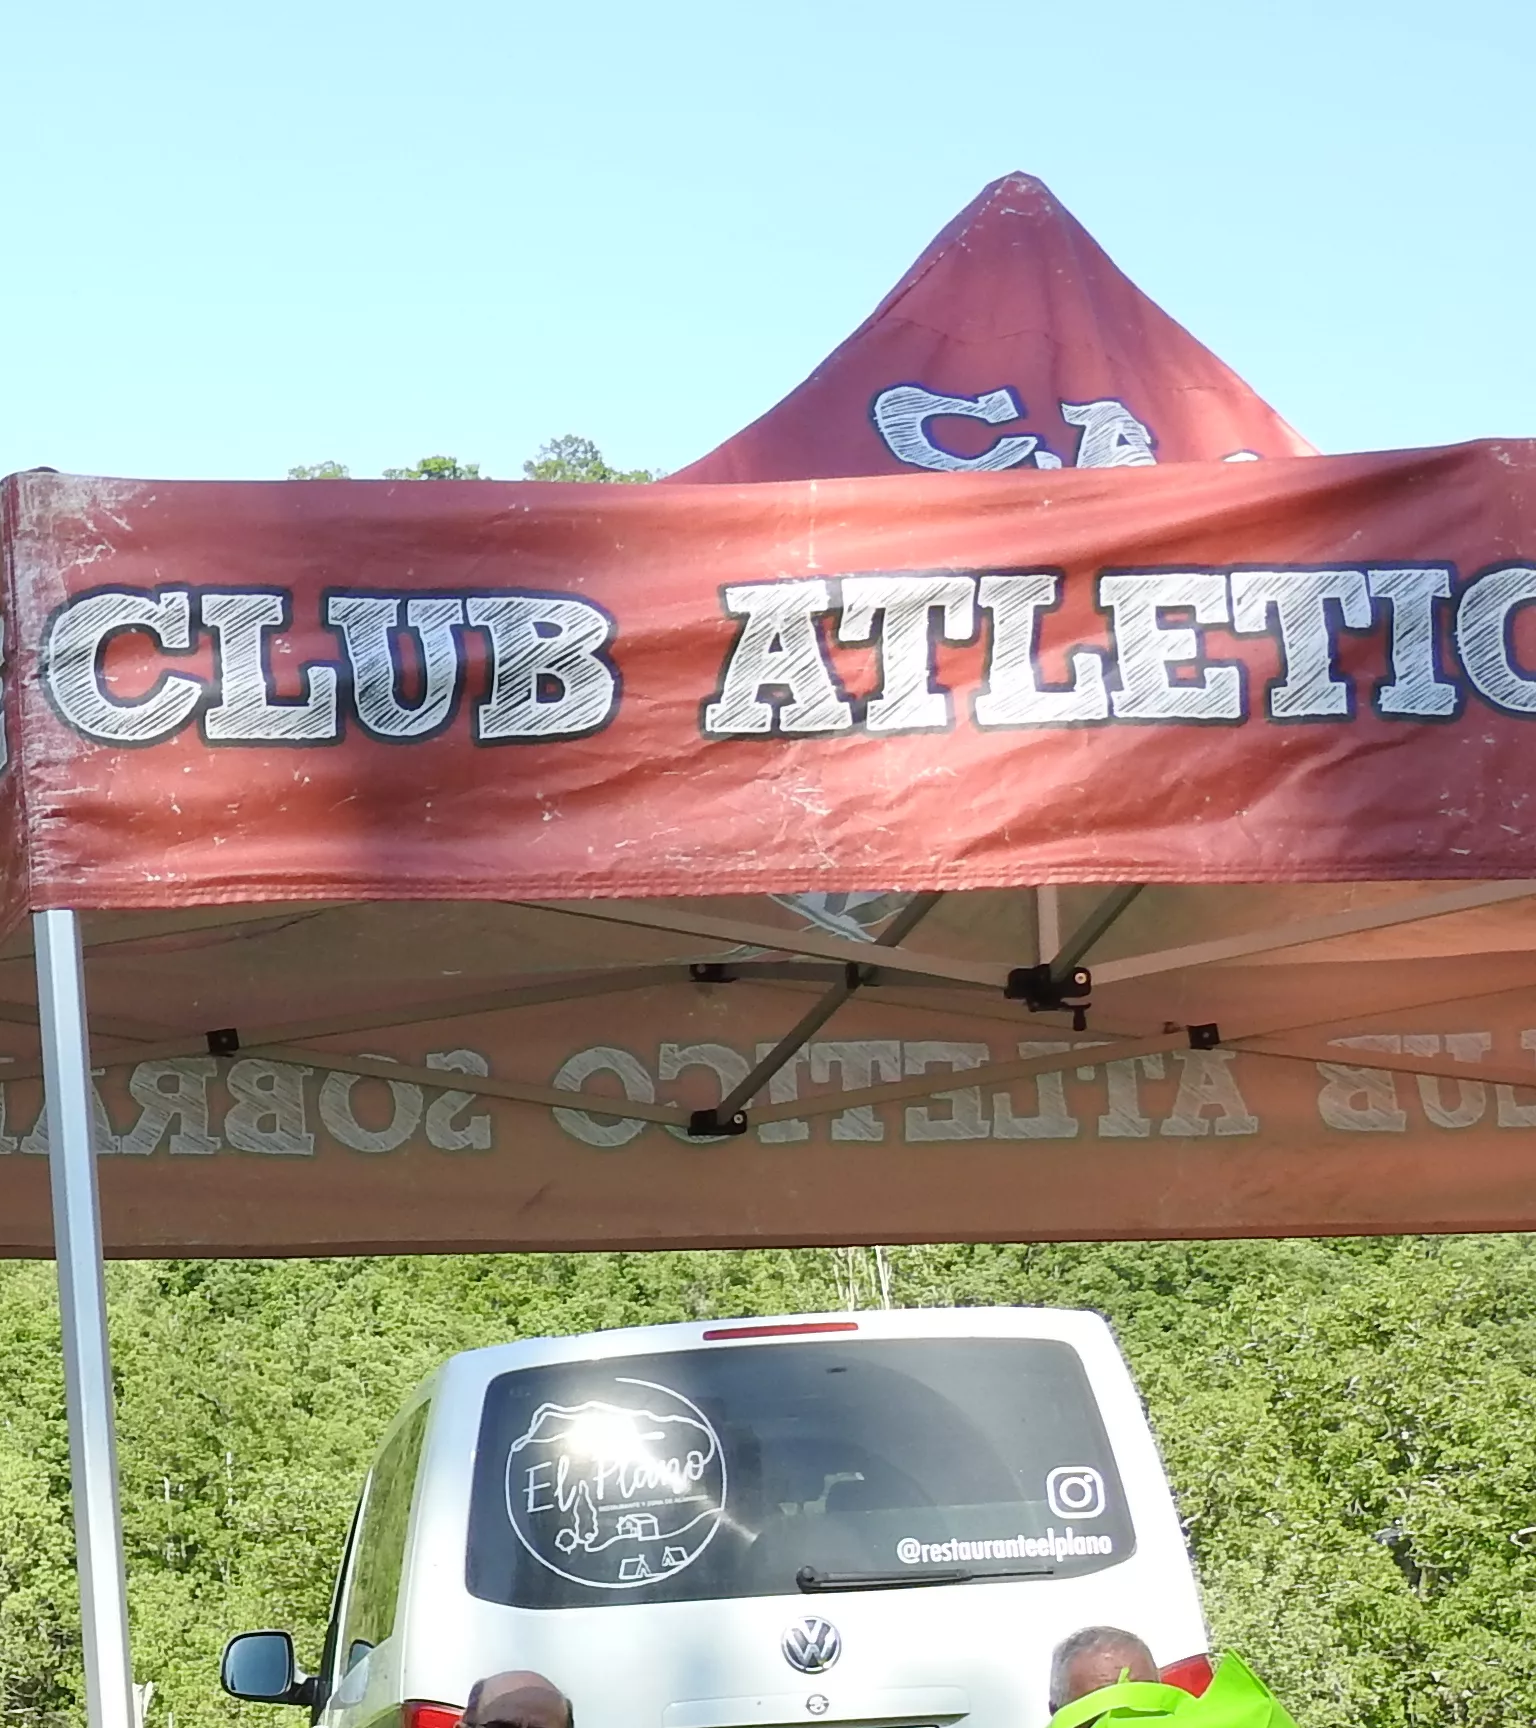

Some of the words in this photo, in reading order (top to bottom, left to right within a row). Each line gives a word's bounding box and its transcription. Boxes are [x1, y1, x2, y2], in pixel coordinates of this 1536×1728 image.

[45, 590, 618, 744] CLUB
[702, 566, 1536, 735] ATLETIC
[896, 1526, 1113, 1565] @restauranteelplano
